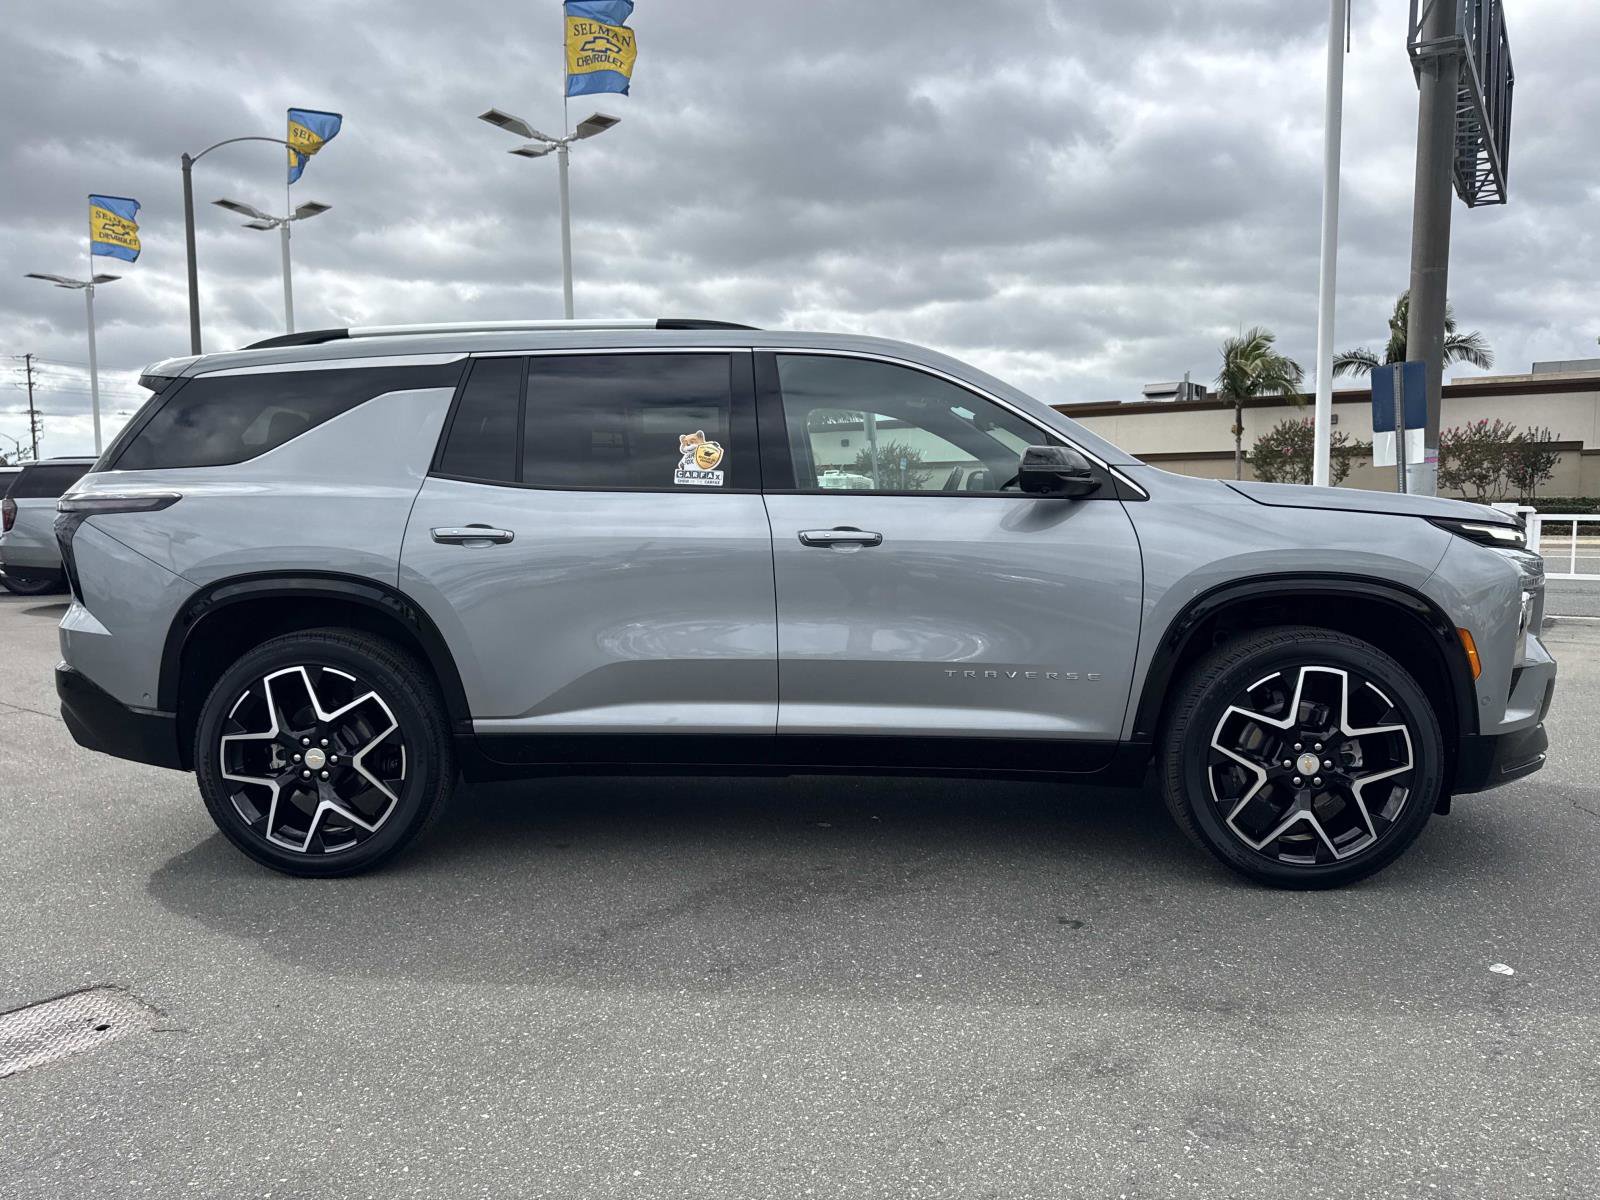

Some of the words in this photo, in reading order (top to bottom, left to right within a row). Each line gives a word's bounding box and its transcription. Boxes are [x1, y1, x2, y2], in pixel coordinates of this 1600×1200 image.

[573, 23, 632, 48] SELMAN
[576, 53, 625, 68] CHEVROLET
[676, 470, 721, 481] CARFAX
[944, 669, 1102, 681] TRAVERSE
